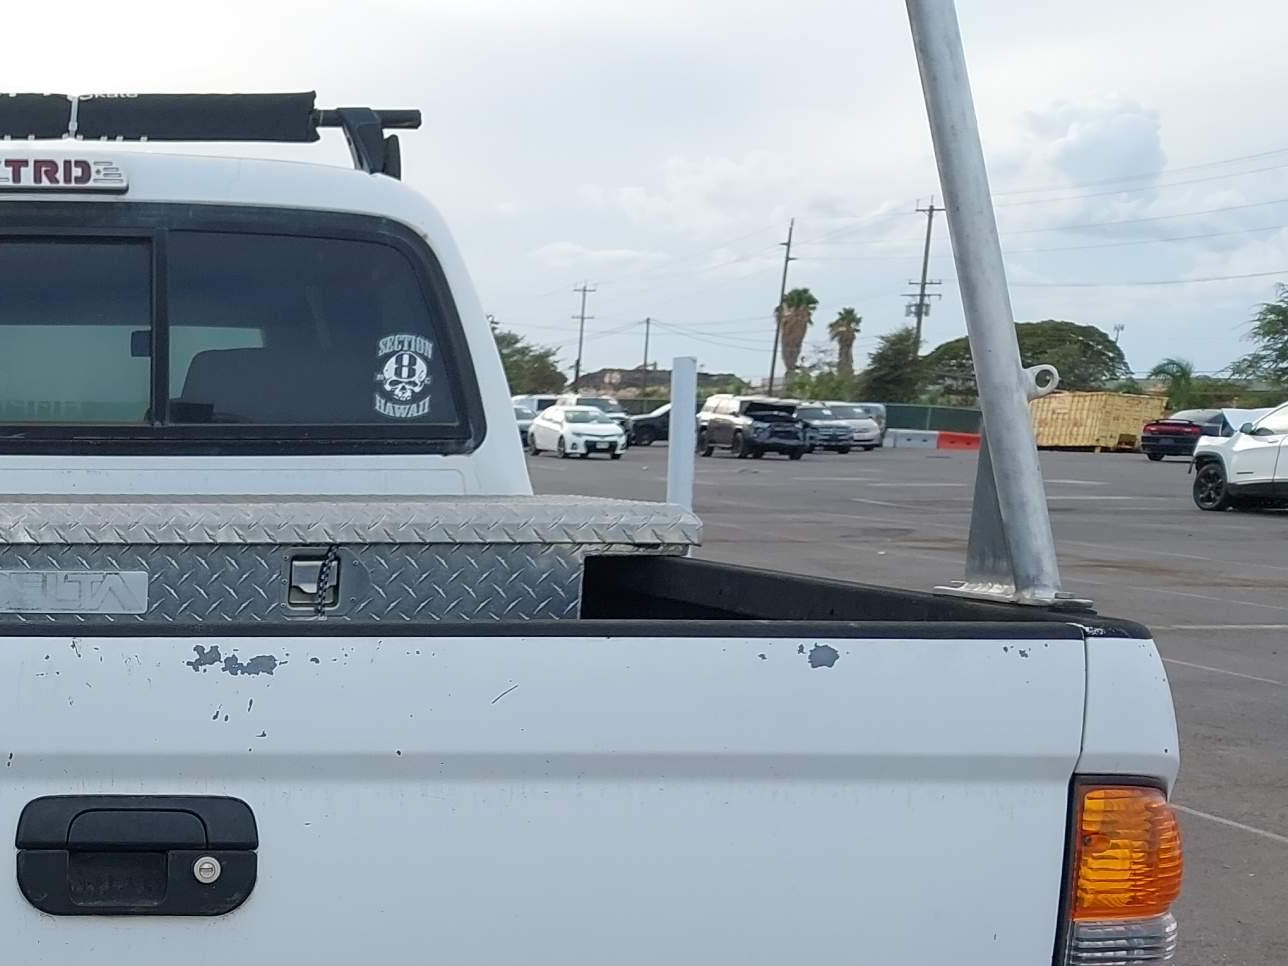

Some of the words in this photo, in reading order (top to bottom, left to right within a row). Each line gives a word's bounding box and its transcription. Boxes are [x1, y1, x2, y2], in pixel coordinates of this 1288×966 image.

[5, 159, 92, 185] TRD
[378, 335, 432, 359] SECTION
[376, 394, 431, 417] HAWAII
